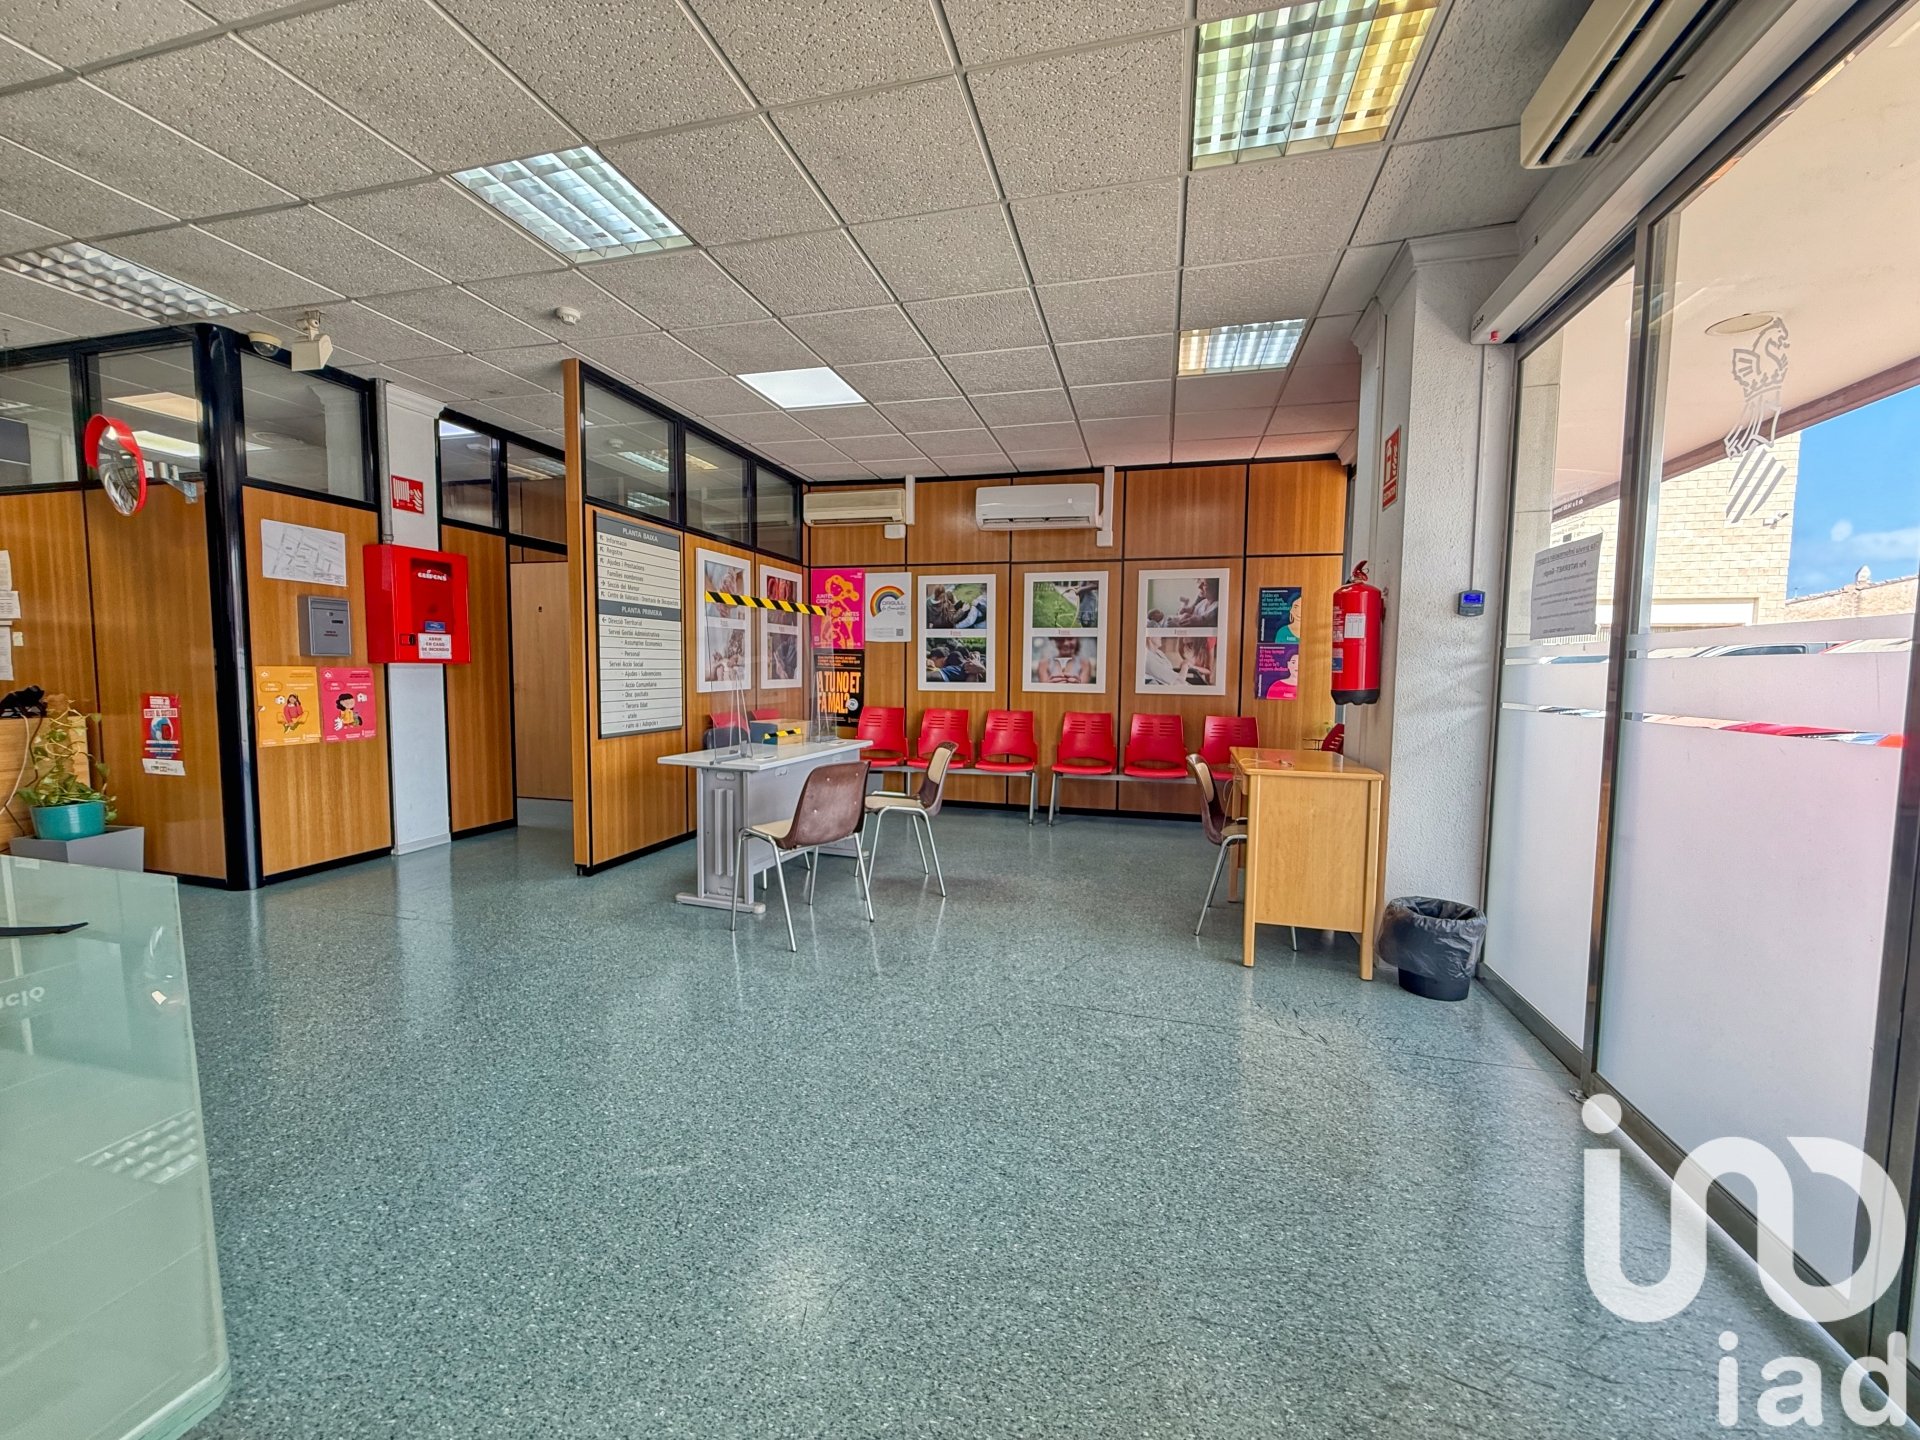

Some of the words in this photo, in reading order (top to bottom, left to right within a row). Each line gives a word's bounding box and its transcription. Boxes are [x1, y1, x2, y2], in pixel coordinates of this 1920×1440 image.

[622, 527, 642, 539] PLANTA
[643, 533, 658, 543] BAIXA
[622, 606, 641, 615] PLANTA
[642, 608, 662, 617] PRIMERA
[824, 671, 836, 693] TU
[836, 671, 850, 693] NO
[850, 672, 861, 693] ET
[817, 692, 827, 713] FA
[828, 692, 851, 714] MAL?
